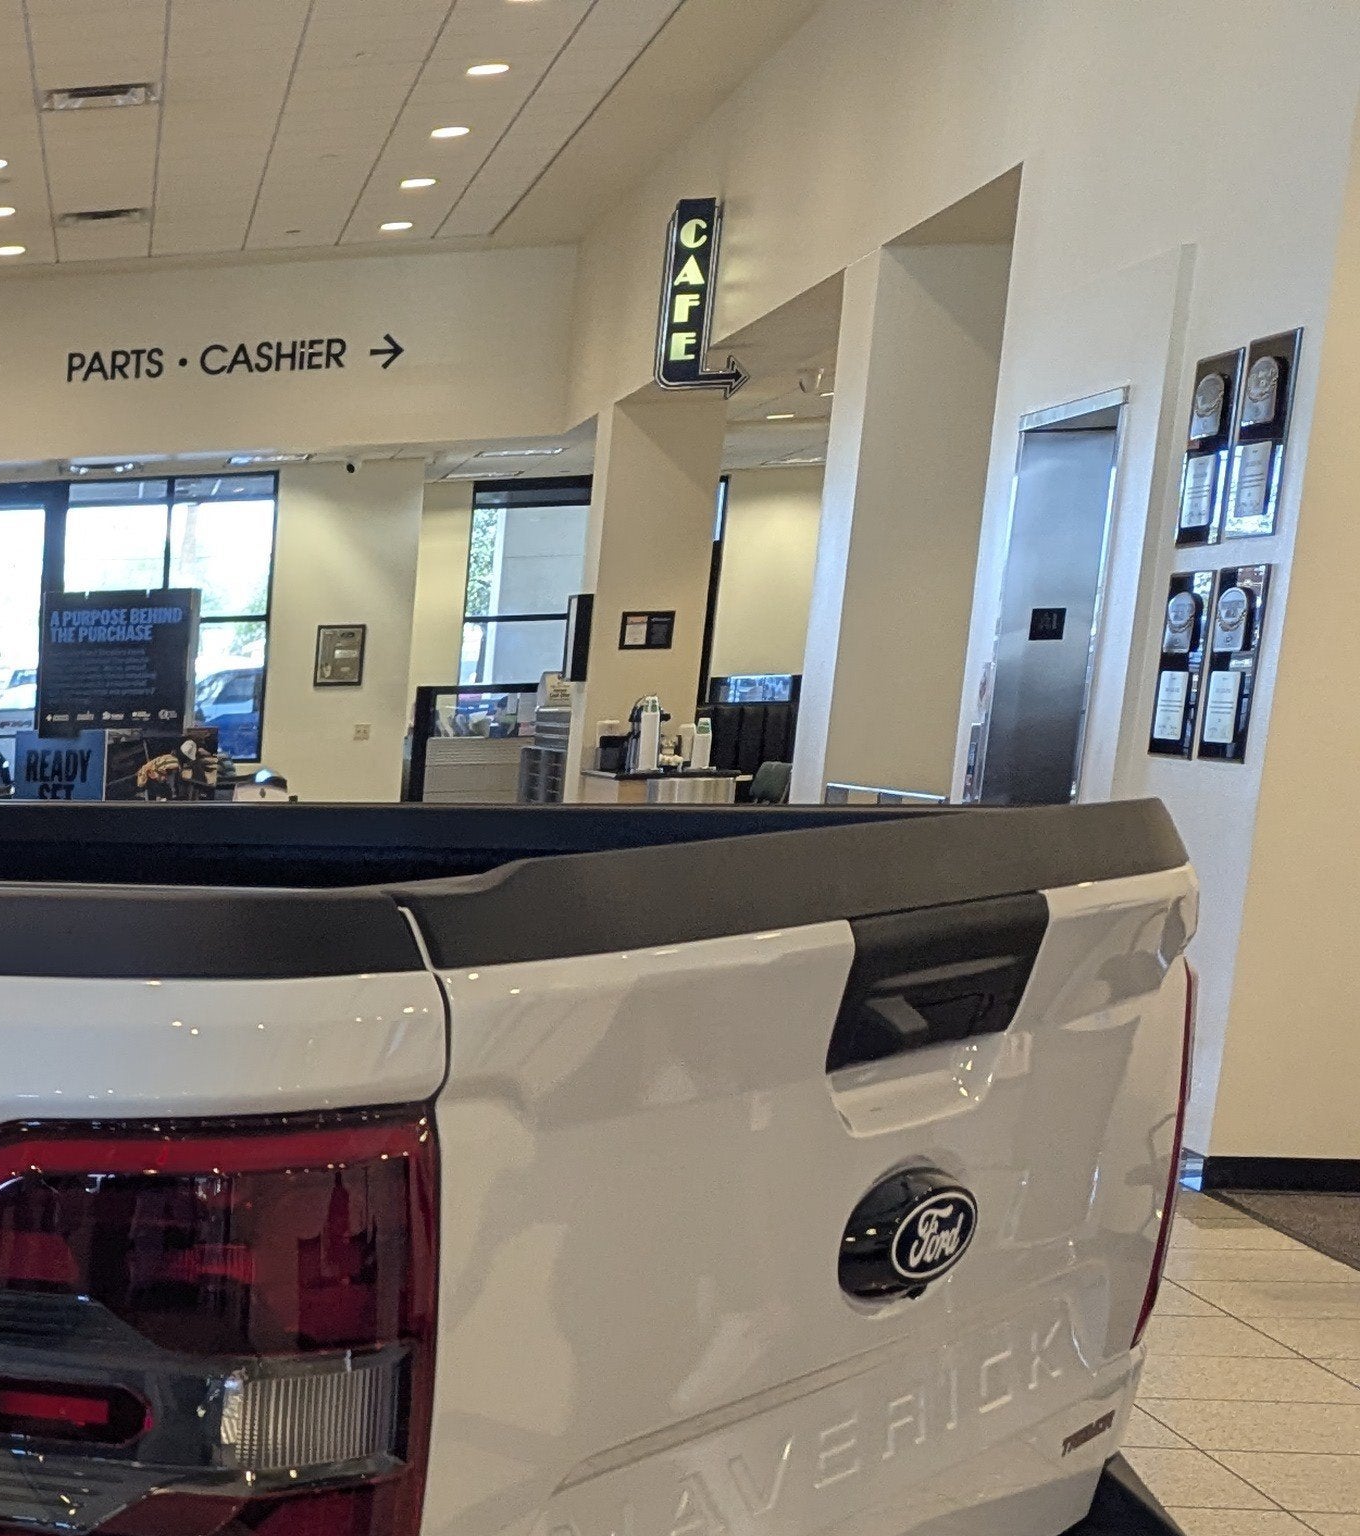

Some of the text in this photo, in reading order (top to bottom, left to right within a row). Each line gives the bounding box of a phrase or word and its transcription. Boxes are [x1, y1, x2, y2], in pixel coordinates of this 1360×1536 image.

[669, 218, 708, 361] CAFE
[66, 337, 347, 383] PARTS CASHIER
[51, 624, 154, 644] THE PURCHASE
[62, 608, 128, 626] PURPOSE
[130, 607, 183, 624] BEHIND
[25, 749, 92, 783] READY
[909, 1204, 964, 1269] Ford
